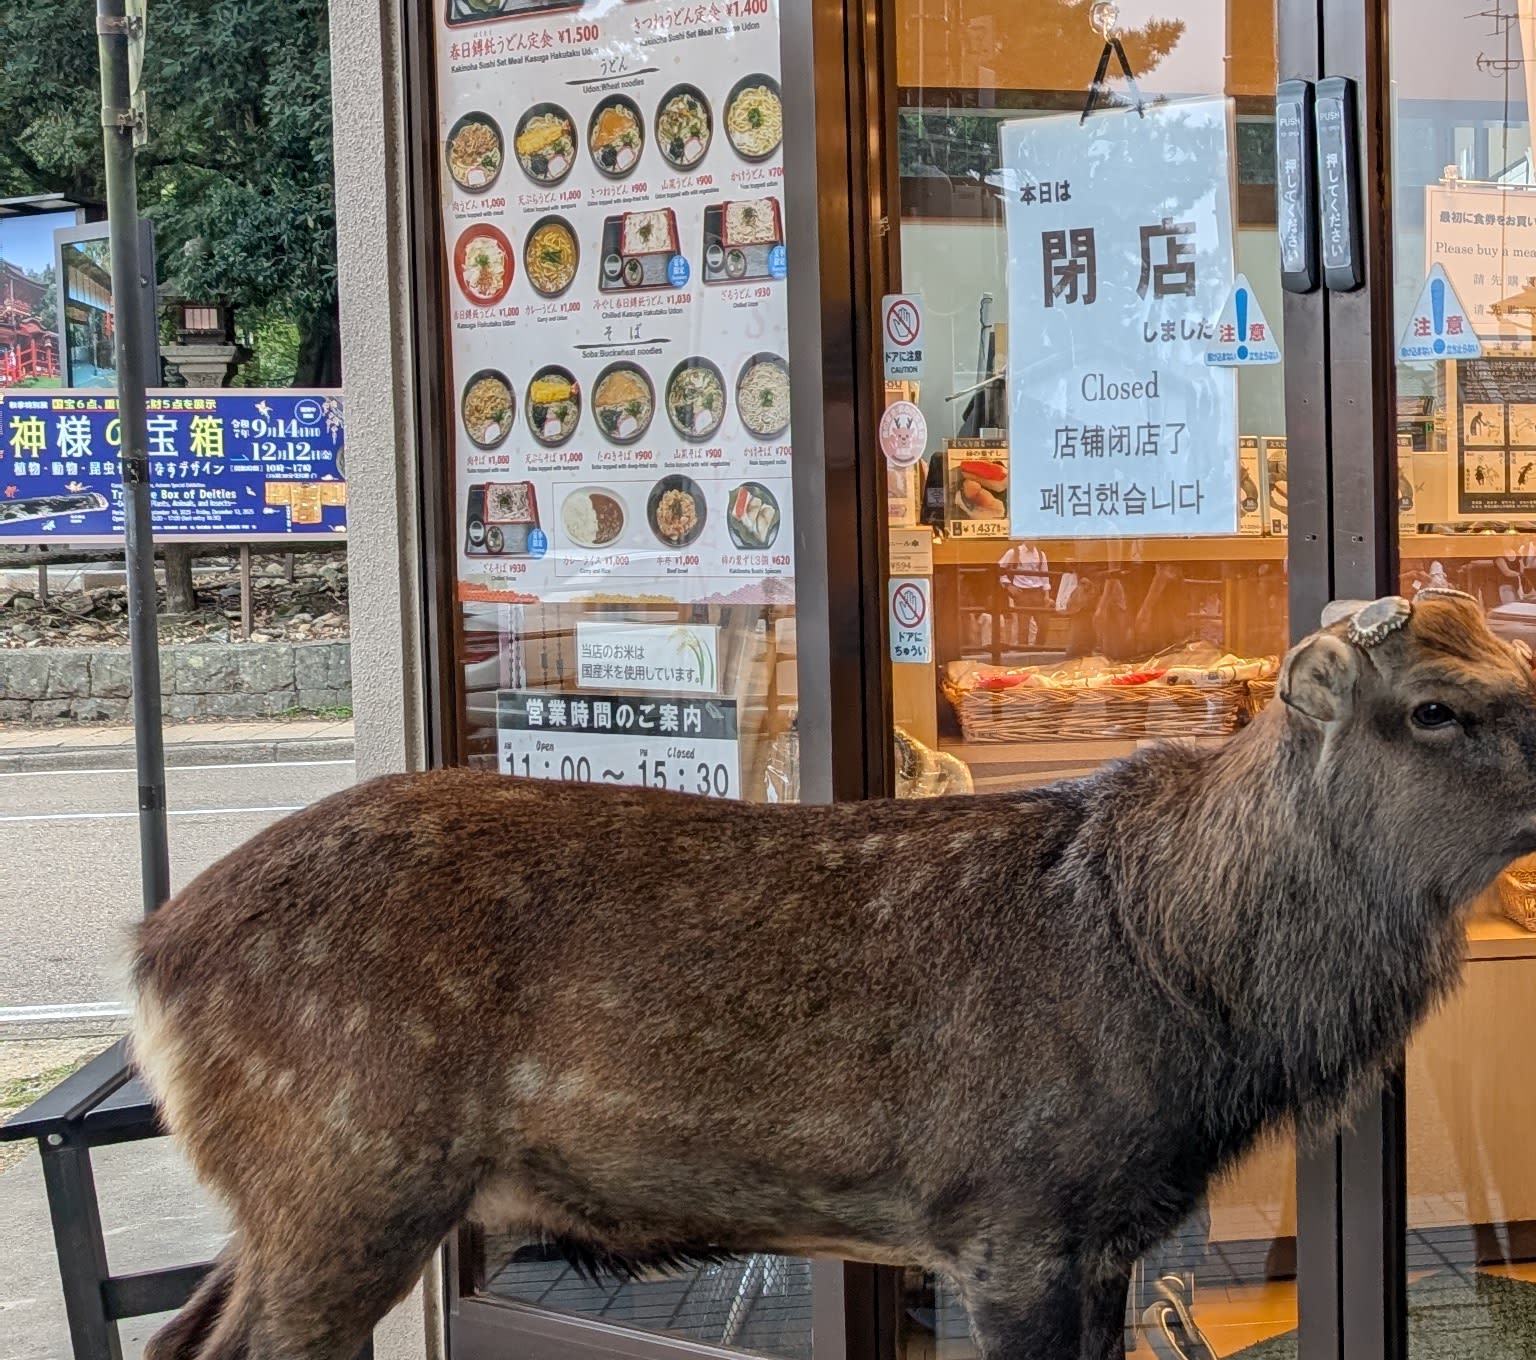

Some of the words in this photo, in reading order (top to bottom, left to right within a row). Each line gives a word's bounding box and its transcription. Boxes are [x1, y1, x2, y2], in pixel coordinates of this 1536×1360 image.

[558, 24, 599, 45] ¥1,500
[714, 24, 741, 35] Kitsne
[601, 56, 628, 75] うどん
[1279, 118, 1300, 127] PUSH
[1320, 111, 1340, 122] PUSH
[1020, 179, 1072, 206] 本日は
[1284, 158, 1299, 262] 押してください
[1326, 153, 1343, 257] 押してください
[1435, 242, 1473, 255] Please
[1477, 243, 1498, 259] buy
[1041, 216, 1196, 308] 閉店
[754, 287, 770, 298] ¥930
[1142, 318, 1213, 343] しました
[1219, 323, 1265, 342] 注意
[1414, 315, 1463, 337] 注意
[886, 350, 922, 363] ドアに注意
[891, 366, 918, 374] CAUTION
[1081, 369, 1160, 402] Closed
[1052, 421, 1186, 459] 店铺闭店了
[635, 449, 652, 461] ¥900
[705, 448, 722, 458] ¥900
[160, 490, 179, 499] Box
[184, 489, 195, 499] of
[1040, 480, 1204, 518] 폐점했습니다
[509, 563, 526, 573] ¥930
[772, 554, 790, 565] ¥620
[899, 631, 923, 643] ドアに
[582, 644, 645, 661] 当店のお米は
[894, 646, 926, 657] ちゅうい
[582, 663, 700, 684] 国産米を使用しています。
[526, 697, 702, 733] 営業時間のご案内
[536, 740, 555, 753] Open
[667, 746, 695, 760] Closed
